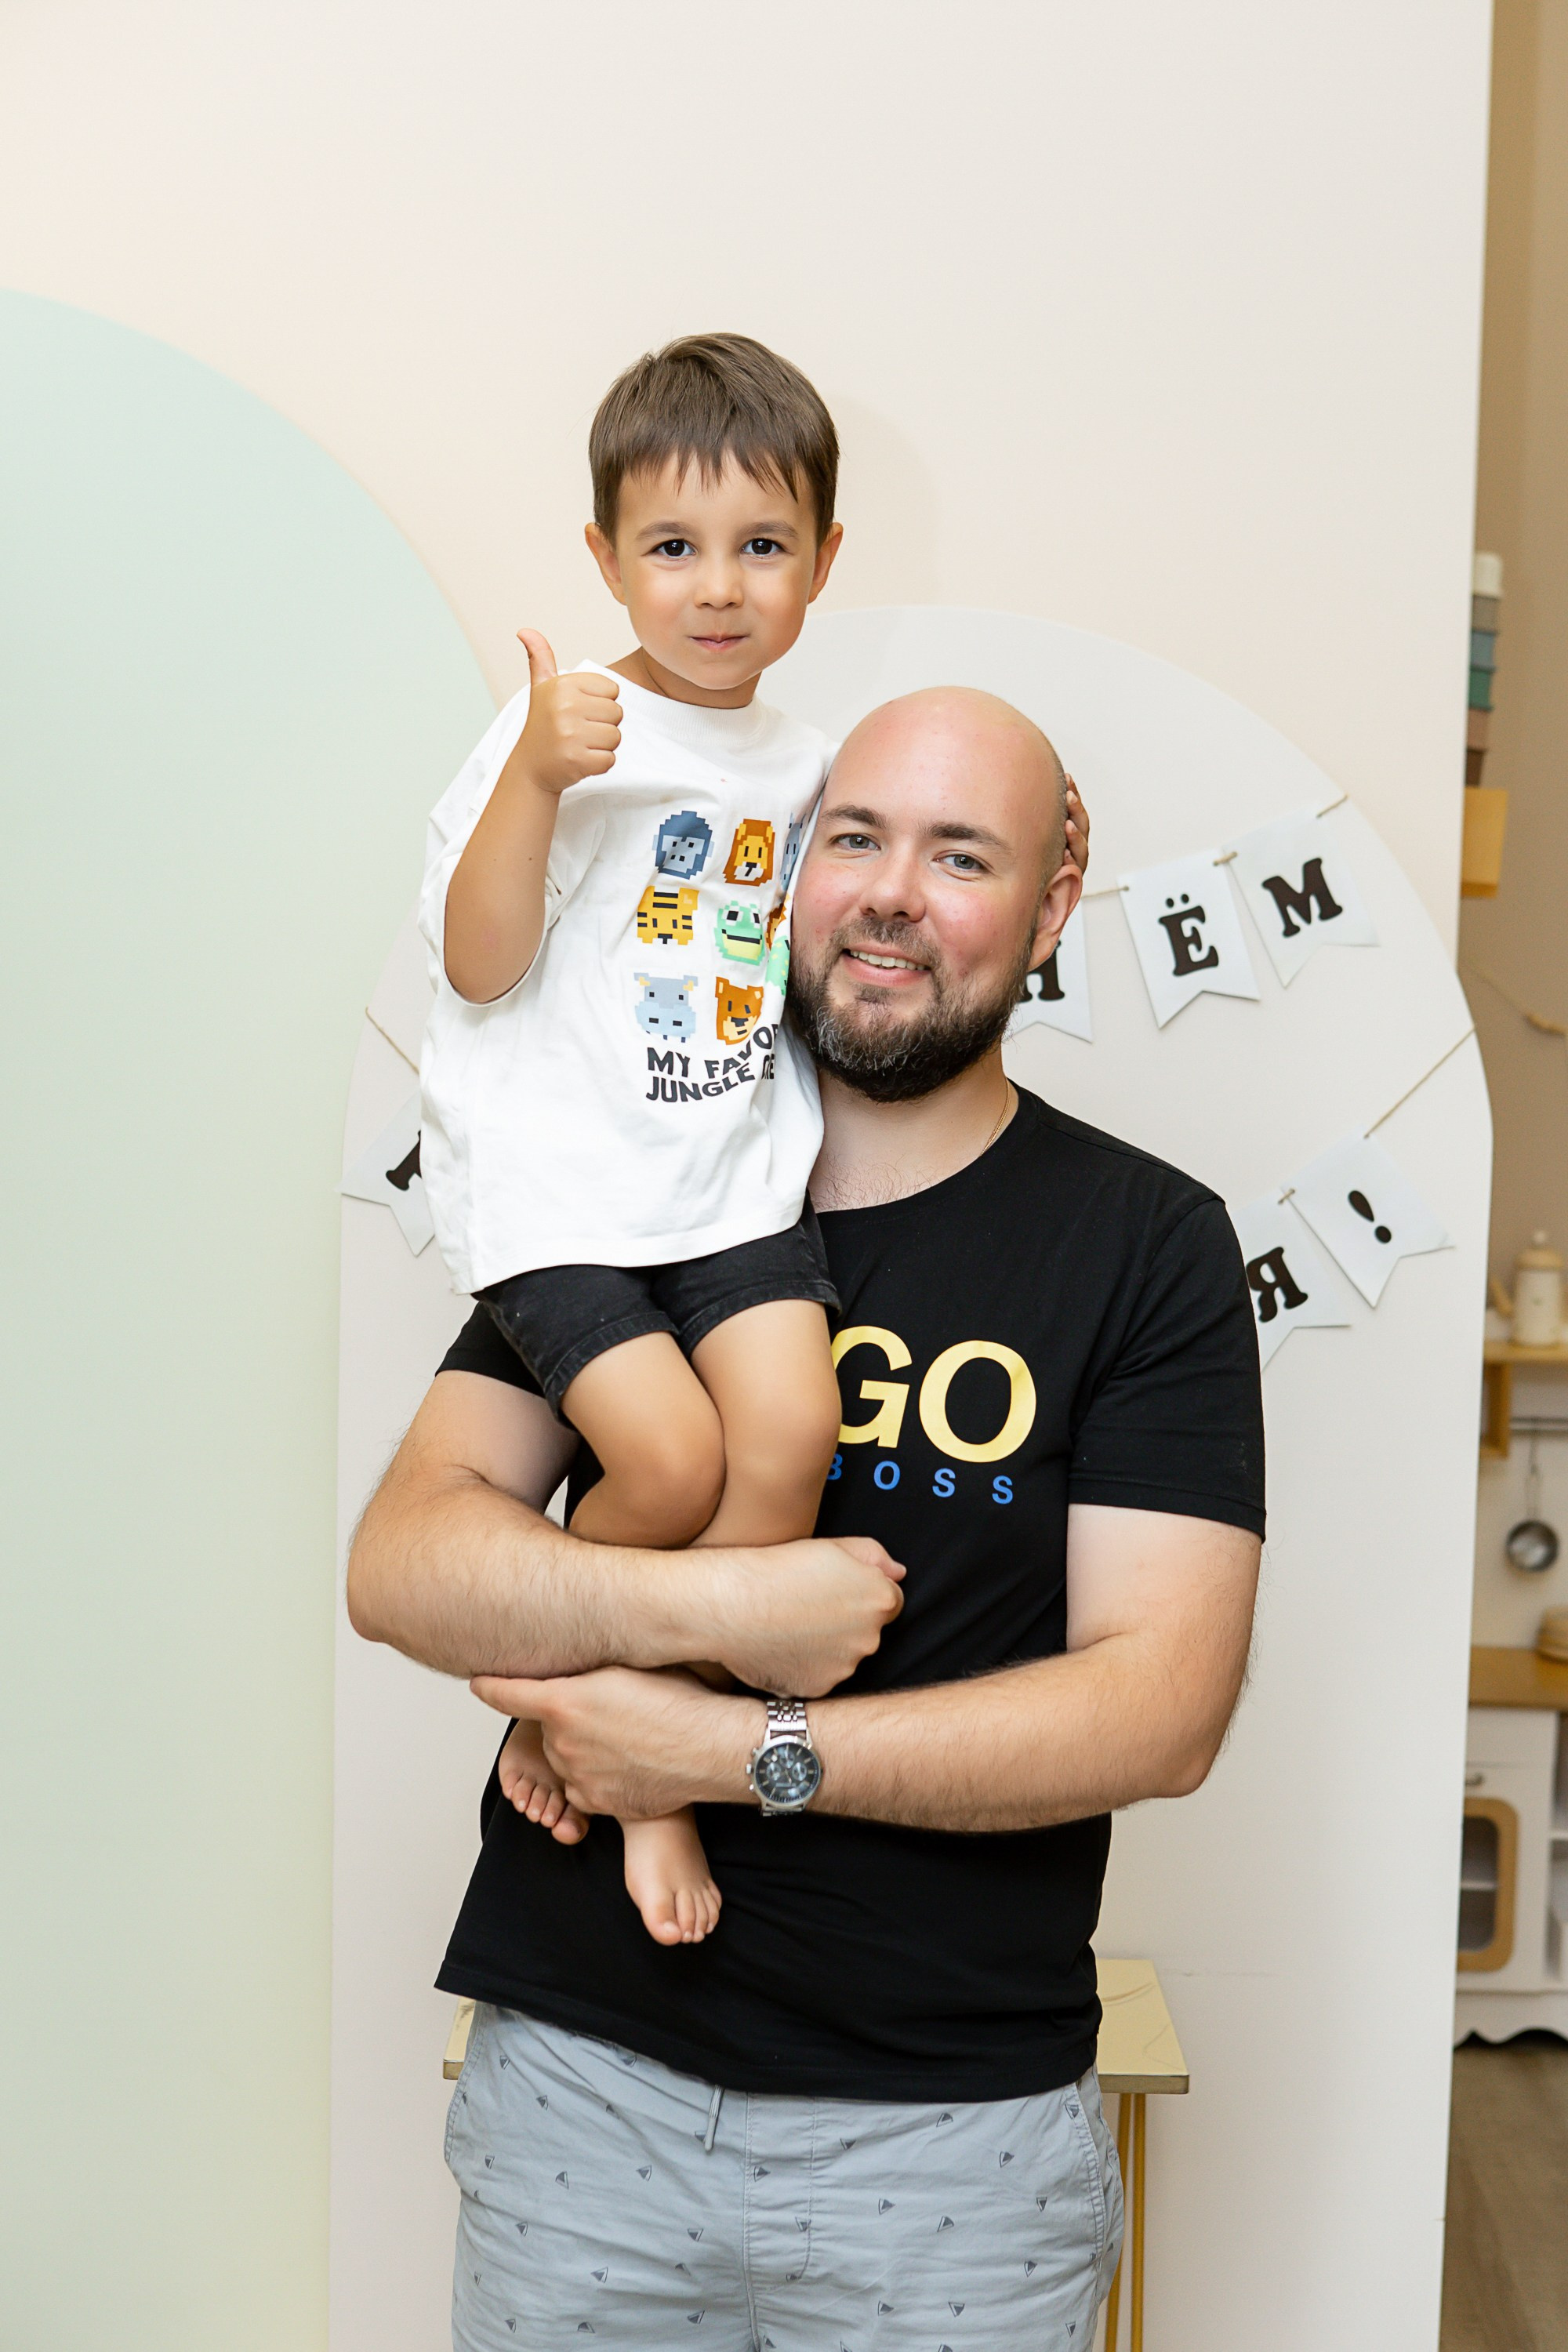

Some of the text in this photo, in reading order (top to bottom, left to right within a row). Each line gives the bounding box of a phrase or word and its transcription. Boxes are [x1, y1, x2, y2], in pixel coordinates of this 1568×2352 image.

[645, 1062, 756, 1103] JUNGLE
[647, 1047, 691, 1077] MY
[830, 1325, 1036, 1463] GO
